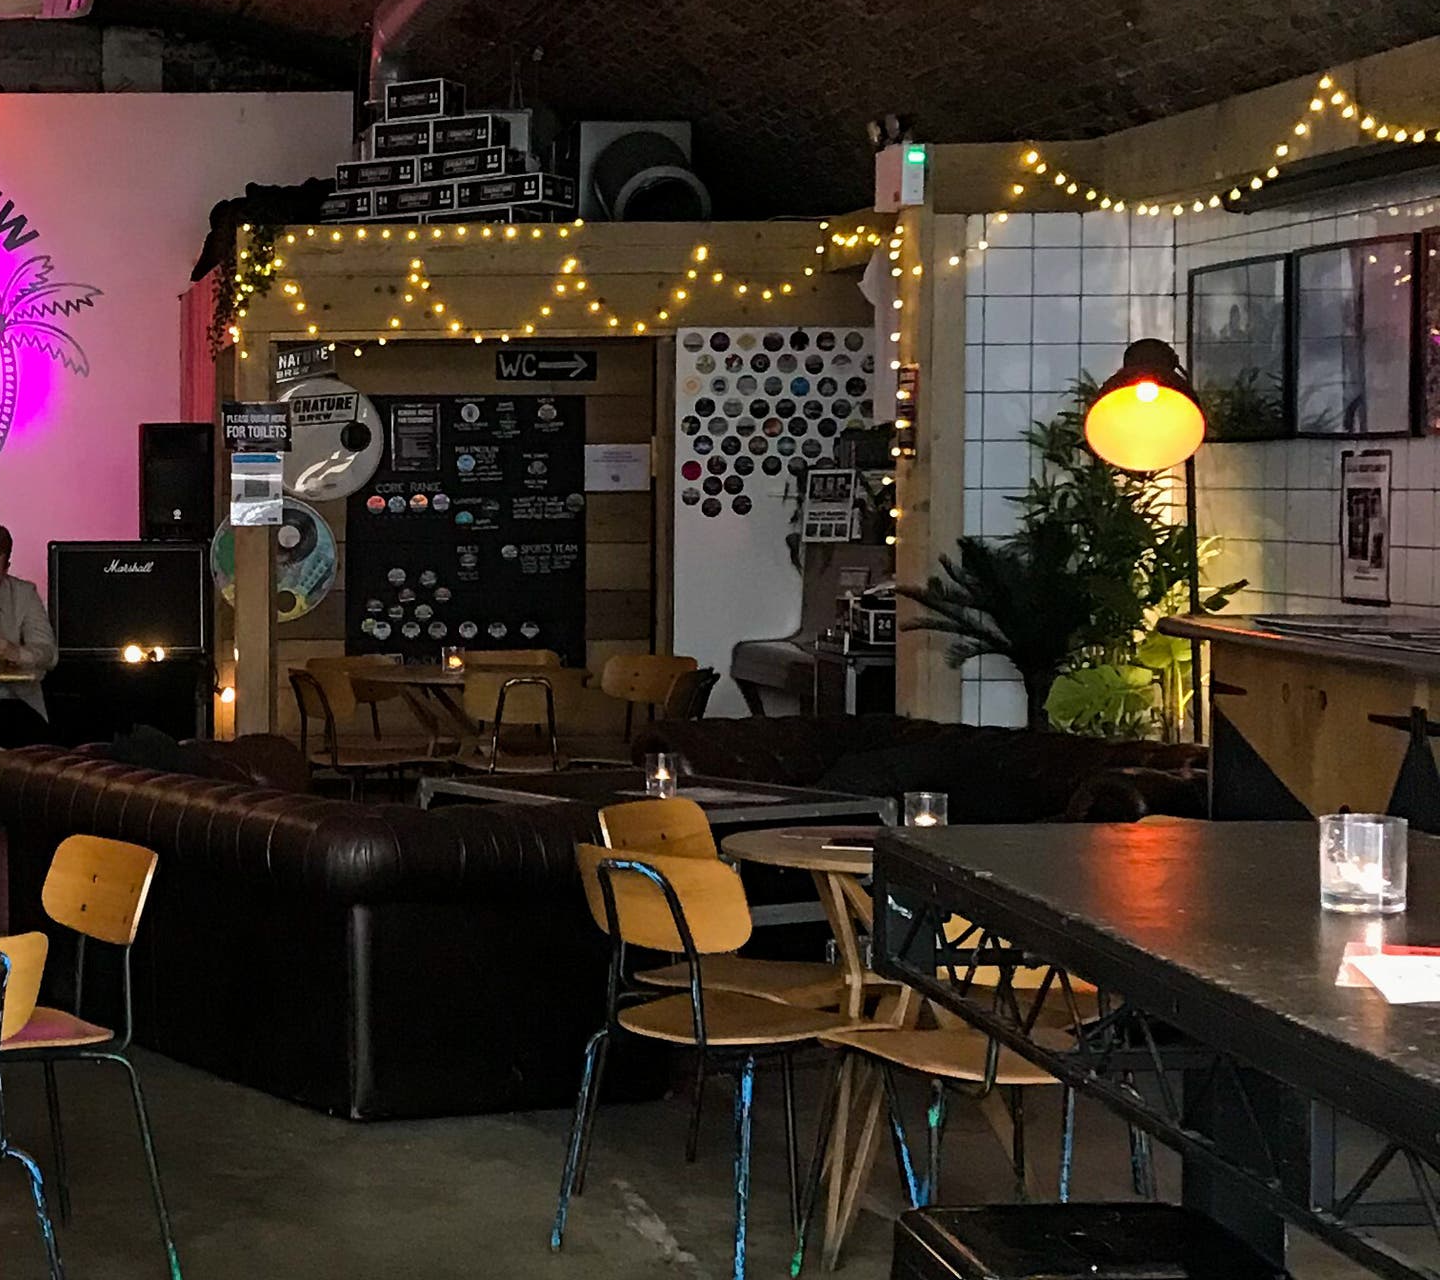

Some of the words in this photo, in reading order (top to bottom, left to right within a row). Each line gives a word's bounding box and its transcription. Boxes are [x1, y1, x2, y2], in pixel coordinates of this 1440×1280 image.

[498, 352, 537, 378] WC
[226, 414, 249, 424] PLEASE
[298, 412, 333, 422] BREW
[226, 425, 246, 439] FOR
[247, 425, 288, 439] TOILETS
[375, 482, 405, 494] CORE
[409, 481, 442, 493] RANGE
[519, 544, 552, 554] SPORTS
[554, 543, 578, 553] TEAM
[103, 559, 155, 573] Marshall
[877, 619, 892, 630] 24
